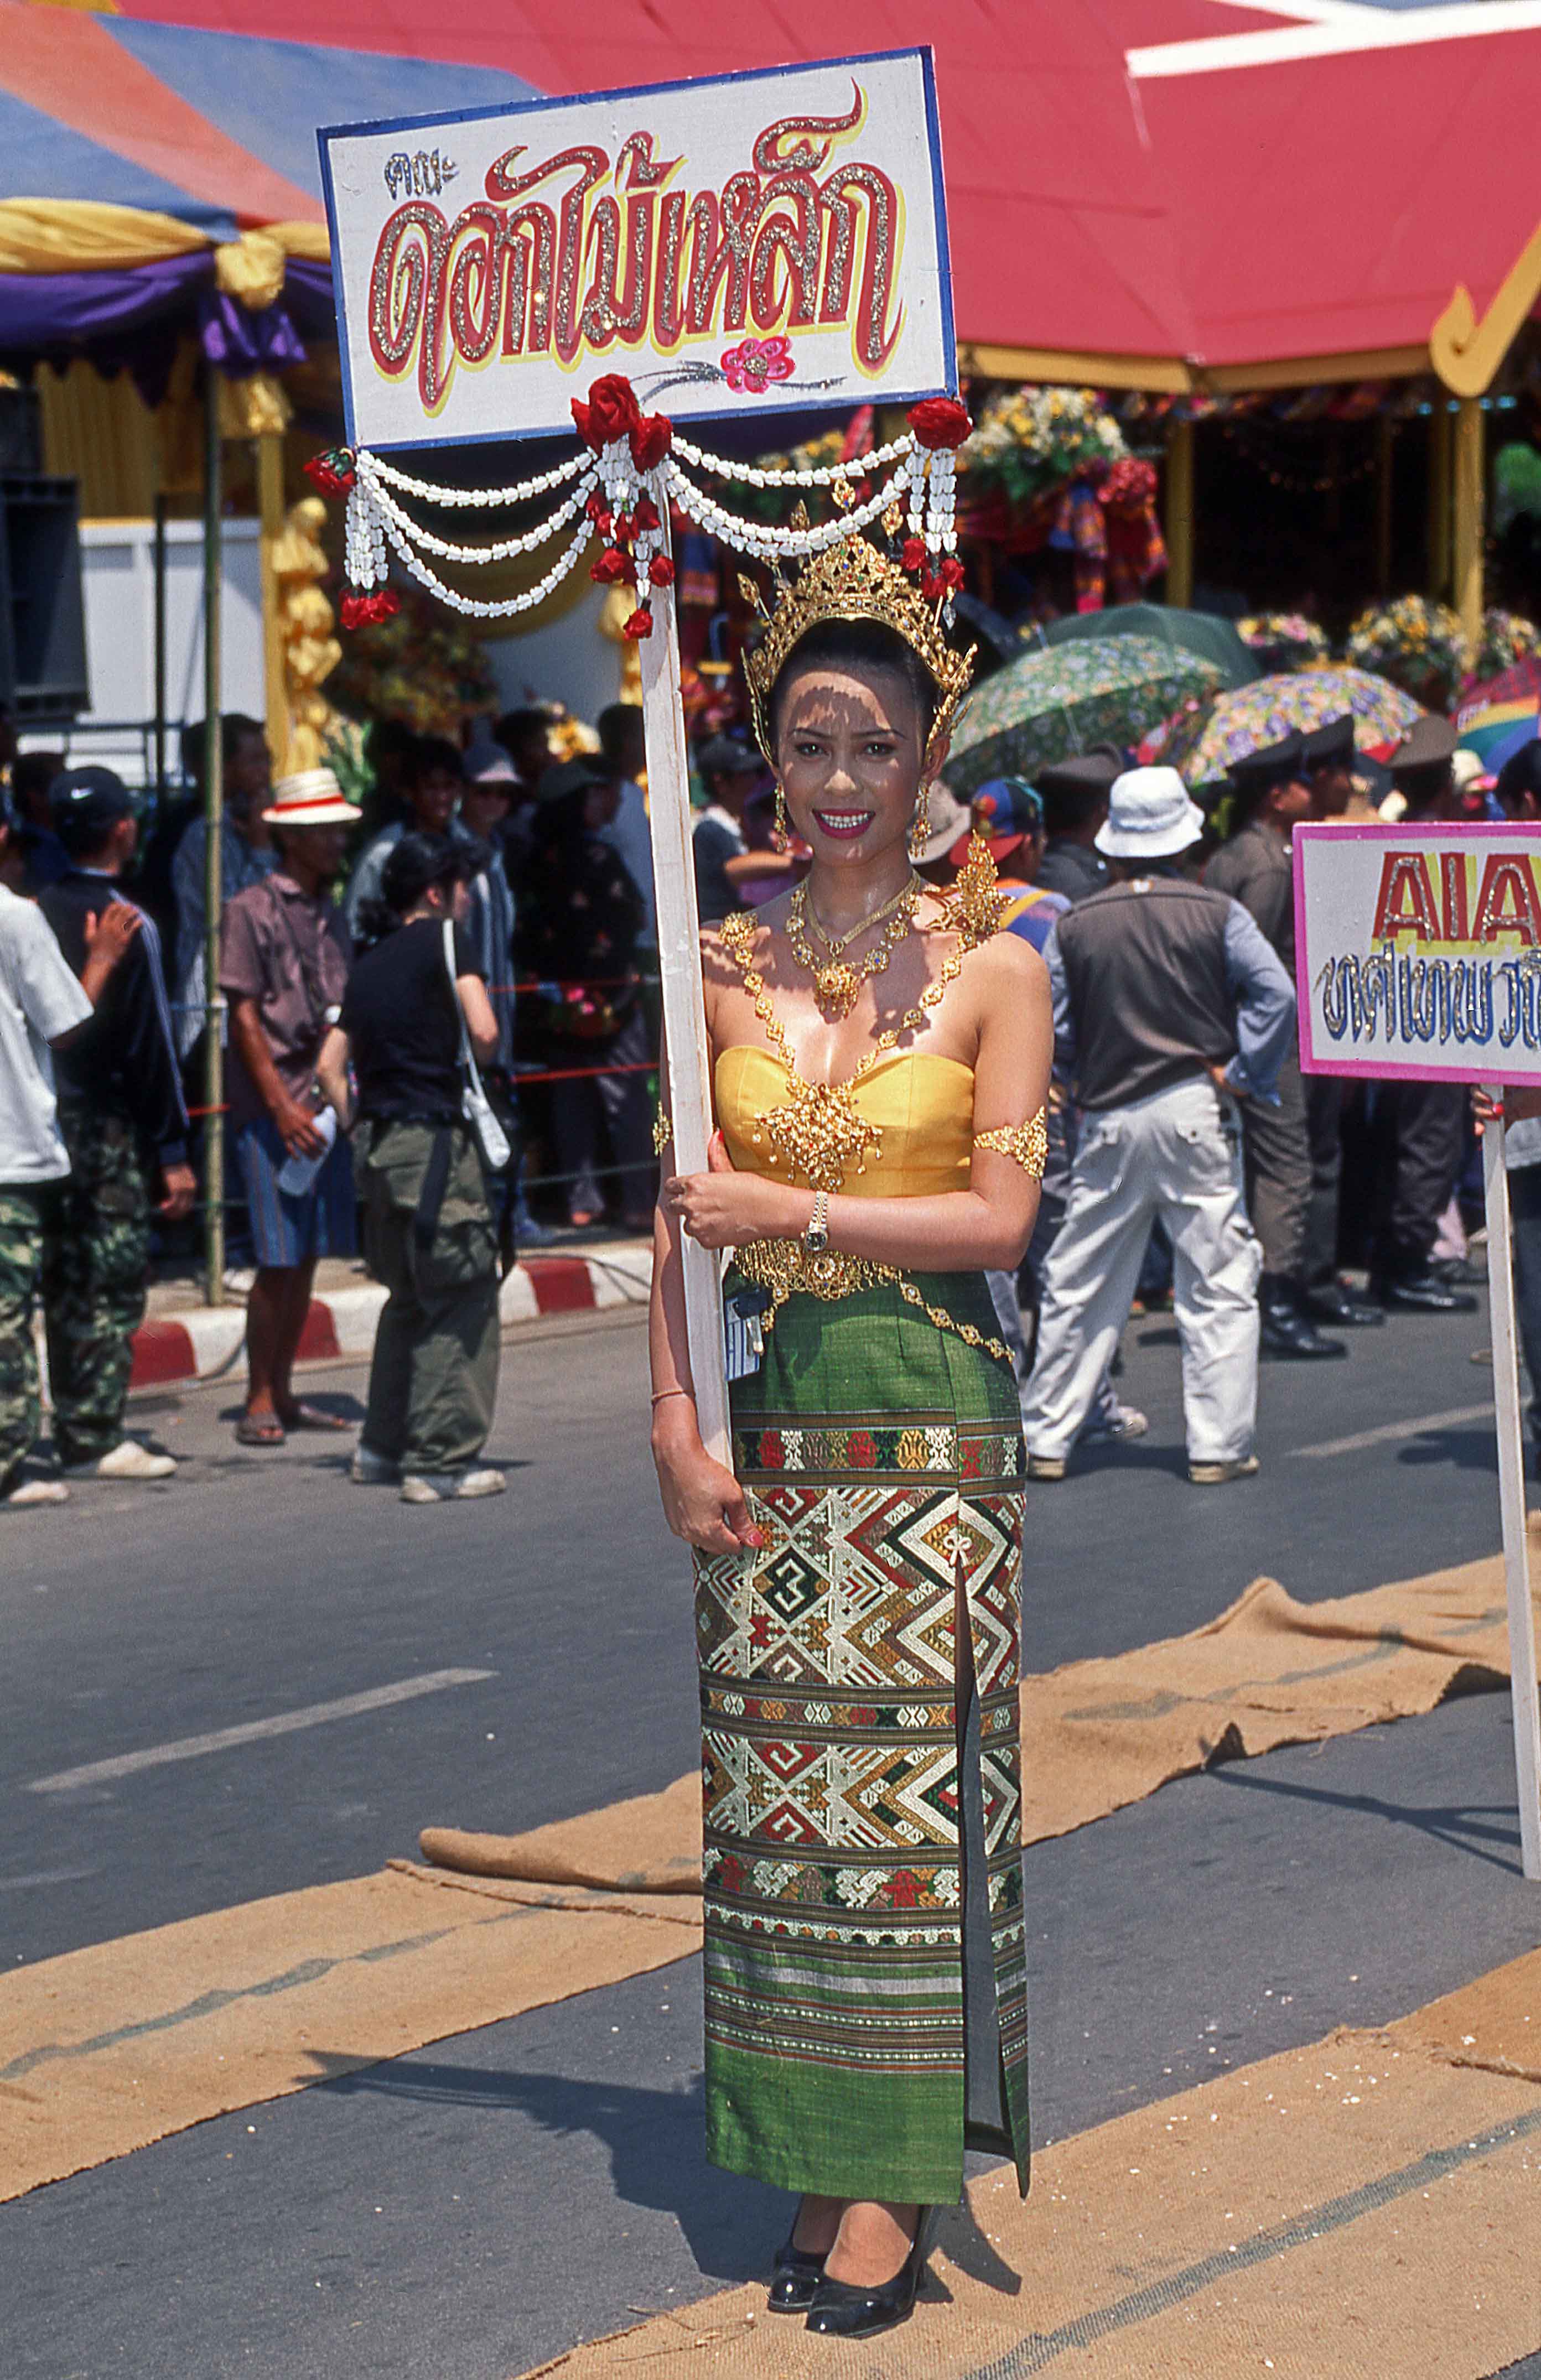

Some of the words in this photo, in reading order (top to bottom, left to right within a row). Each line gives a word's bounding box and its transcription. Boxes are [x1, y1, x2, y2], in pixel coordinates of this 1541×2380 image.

[384, 147, 460, 201] คณะ
[369, 77, 907, 418] ดอกไม้เหล็ก
[1371, 851, 1541, 947] AIA
